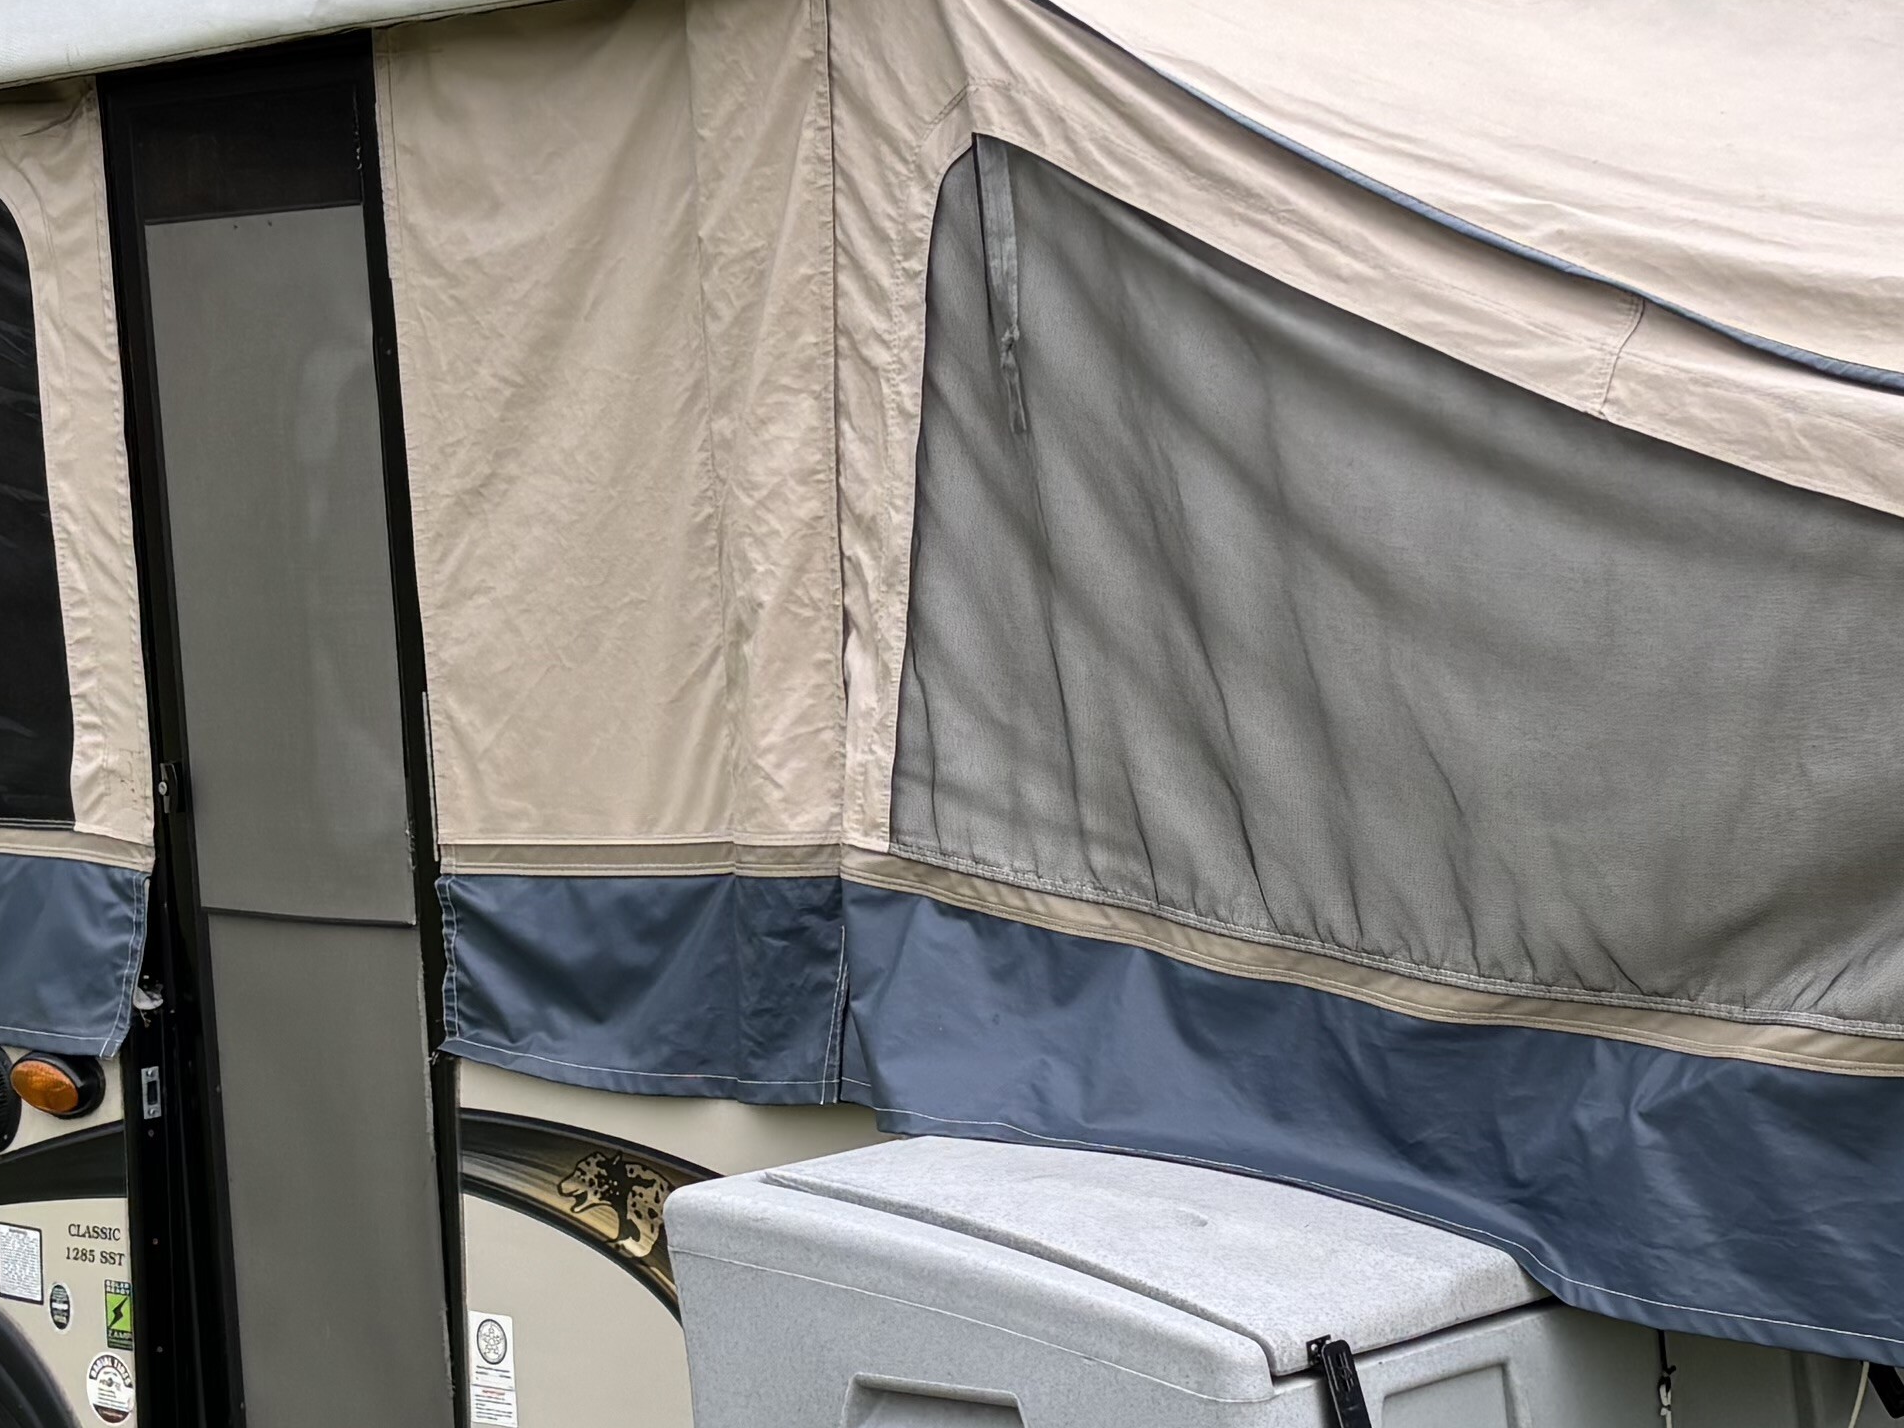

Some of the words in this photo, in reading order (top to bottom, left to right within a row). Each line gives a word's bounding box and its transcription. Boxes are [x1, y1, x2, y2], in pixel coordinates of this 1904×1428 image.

[68, 1223, 121, 1241] CLASSIC
[65, 1246, 96, 1263] 1285
[99, 1250, 125, 1266] SST
